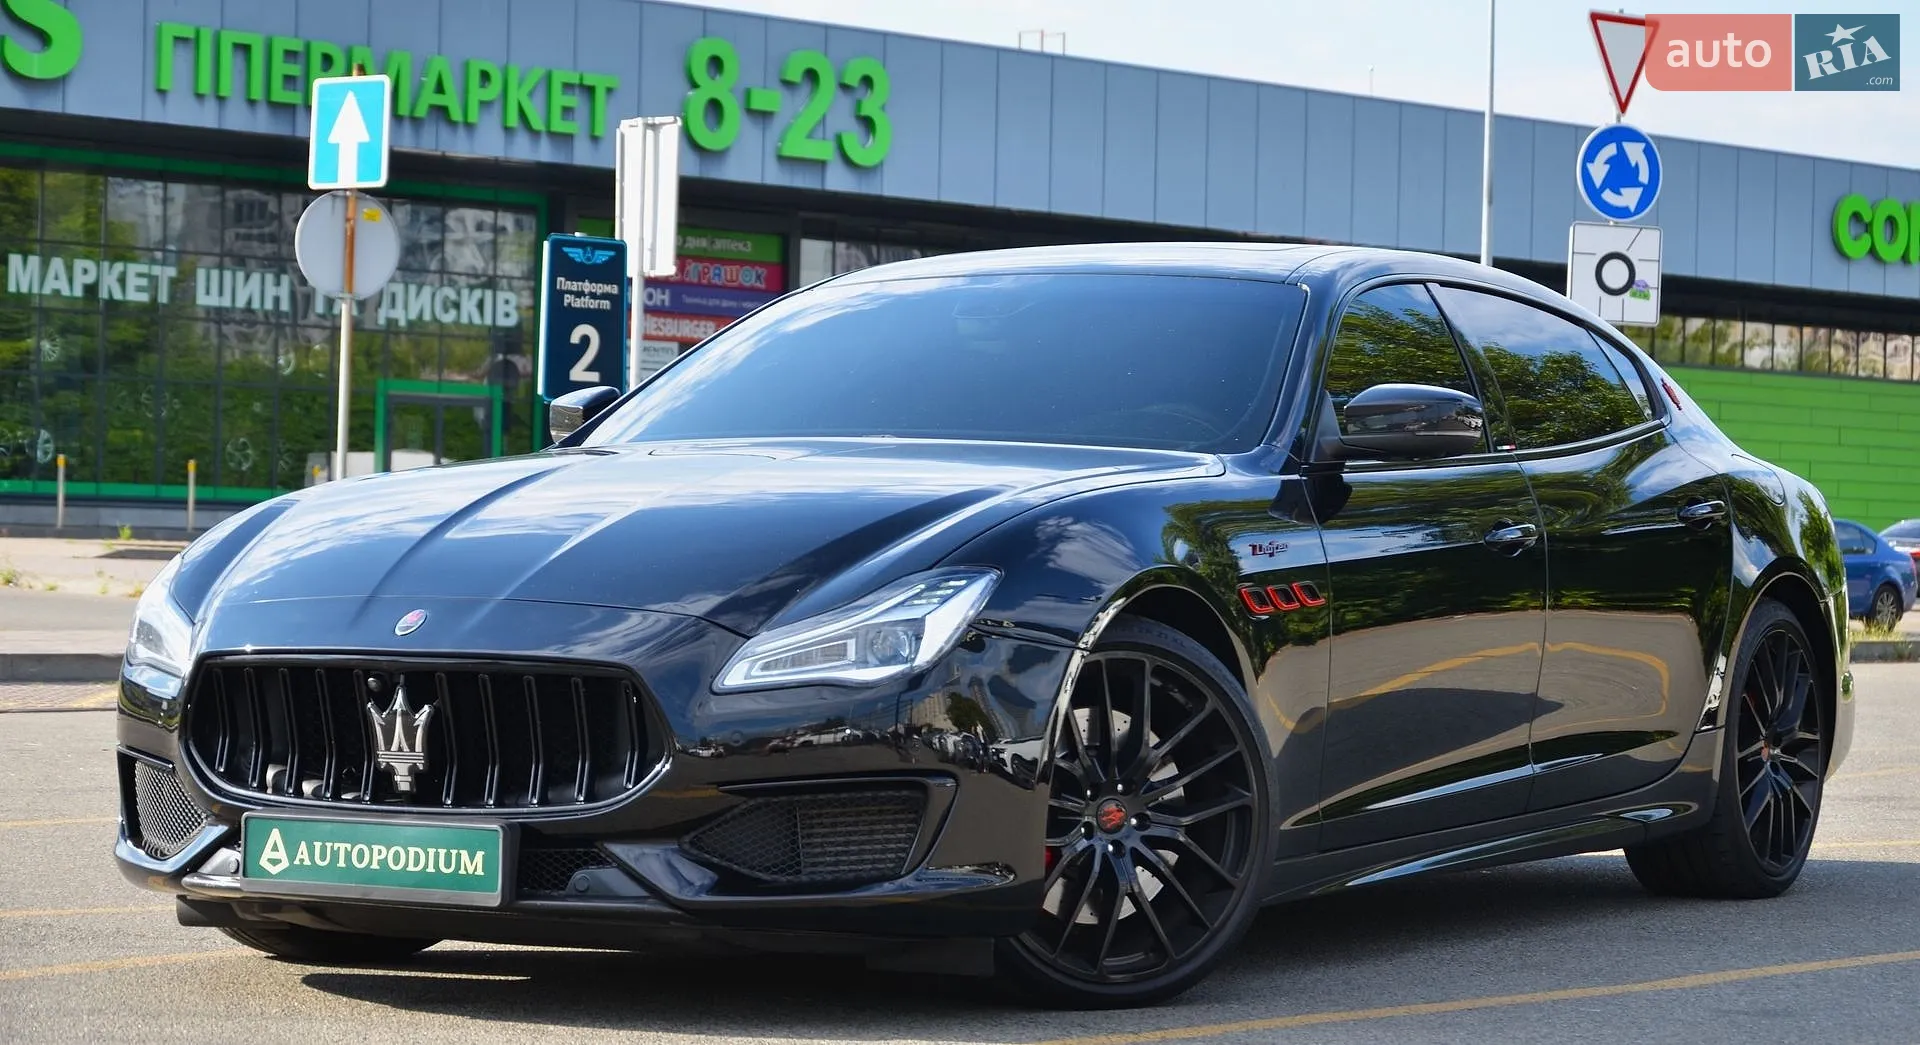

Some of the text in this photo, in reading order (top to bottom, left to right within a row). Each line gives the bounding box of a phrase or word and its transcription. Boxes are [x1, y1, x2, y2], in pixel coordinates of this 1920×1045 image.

[156, 21, 892, 168] ГІПЕРМАРКЕТ 8-23
[7, 253, 177, 304] МАРКЕТ
[196, 266, 290, 312] ШИН
[377, 282, 519, 327] ДИСКІВ
[556, 276, 619, 296] Платформа
[563, 293, 612, 310] Platform
[569, 323, 600, 382] 2
[293, 840, 485, 876] AUTOPODIUM
